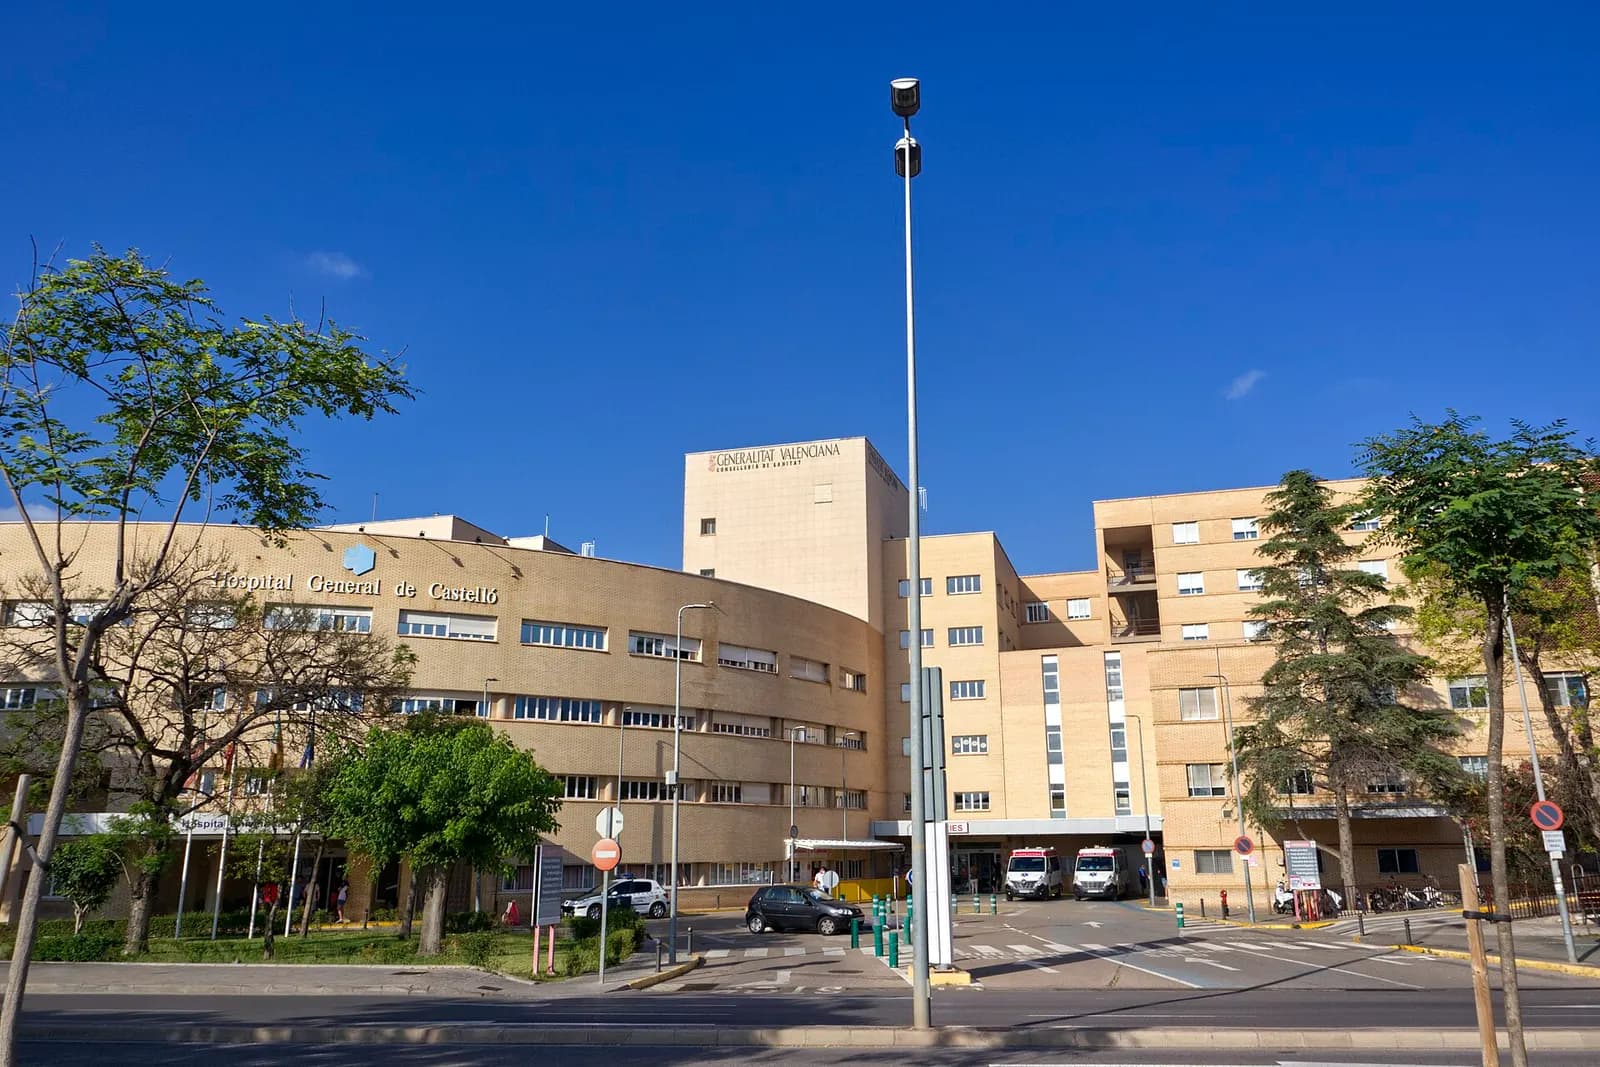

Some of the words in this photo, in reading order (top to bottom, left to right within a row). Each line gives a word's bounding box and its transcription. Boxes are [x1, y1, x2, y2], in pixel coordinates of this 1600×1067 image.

[716, 449, 775, 466] GENERALITAT
[780, 443, 840, 460] VALENCIANA
[211, 572, 293, 592] Hospital
[307, 574, 381, 594] General
[395, 581, 416, 598] de
[428, 582, 498, 605] Castelló
[181, 818, 226, 829] Hospita
